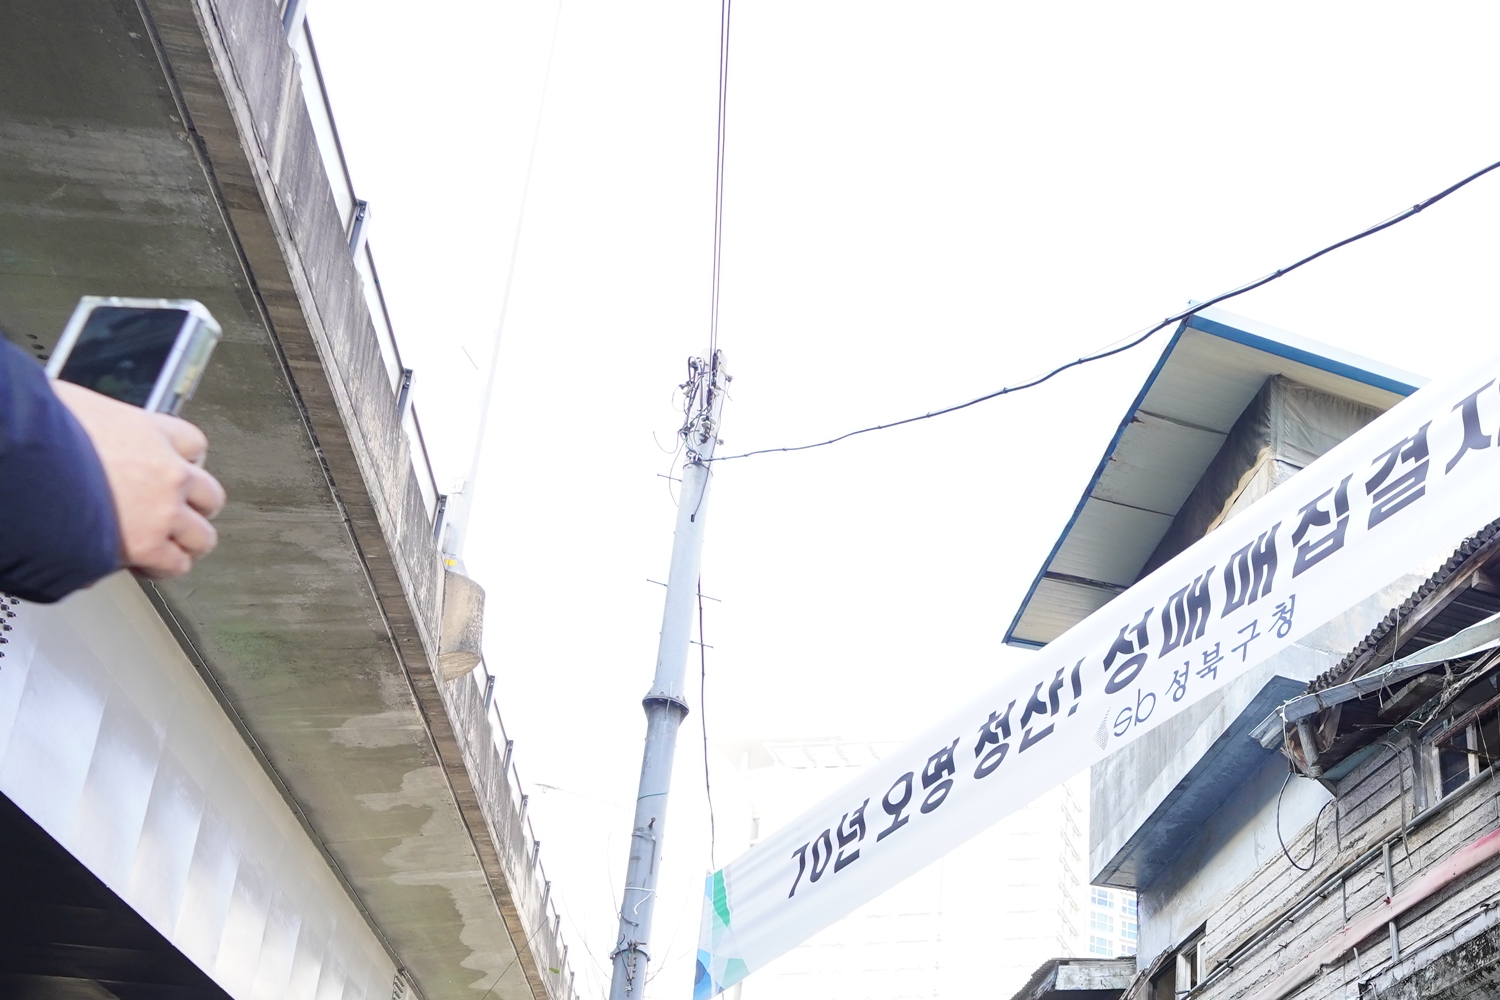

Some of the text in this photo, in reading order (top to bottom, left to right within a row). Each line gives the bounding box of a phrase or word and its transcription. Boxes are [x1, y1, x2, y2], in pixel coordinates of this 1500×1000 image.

[1164, 594, 1297, 703] 성북구청
[788, 797, 870, 899] 70년
[876, 737, 961, 843] 오명
[973, 656, 1087, 781] 청산!
